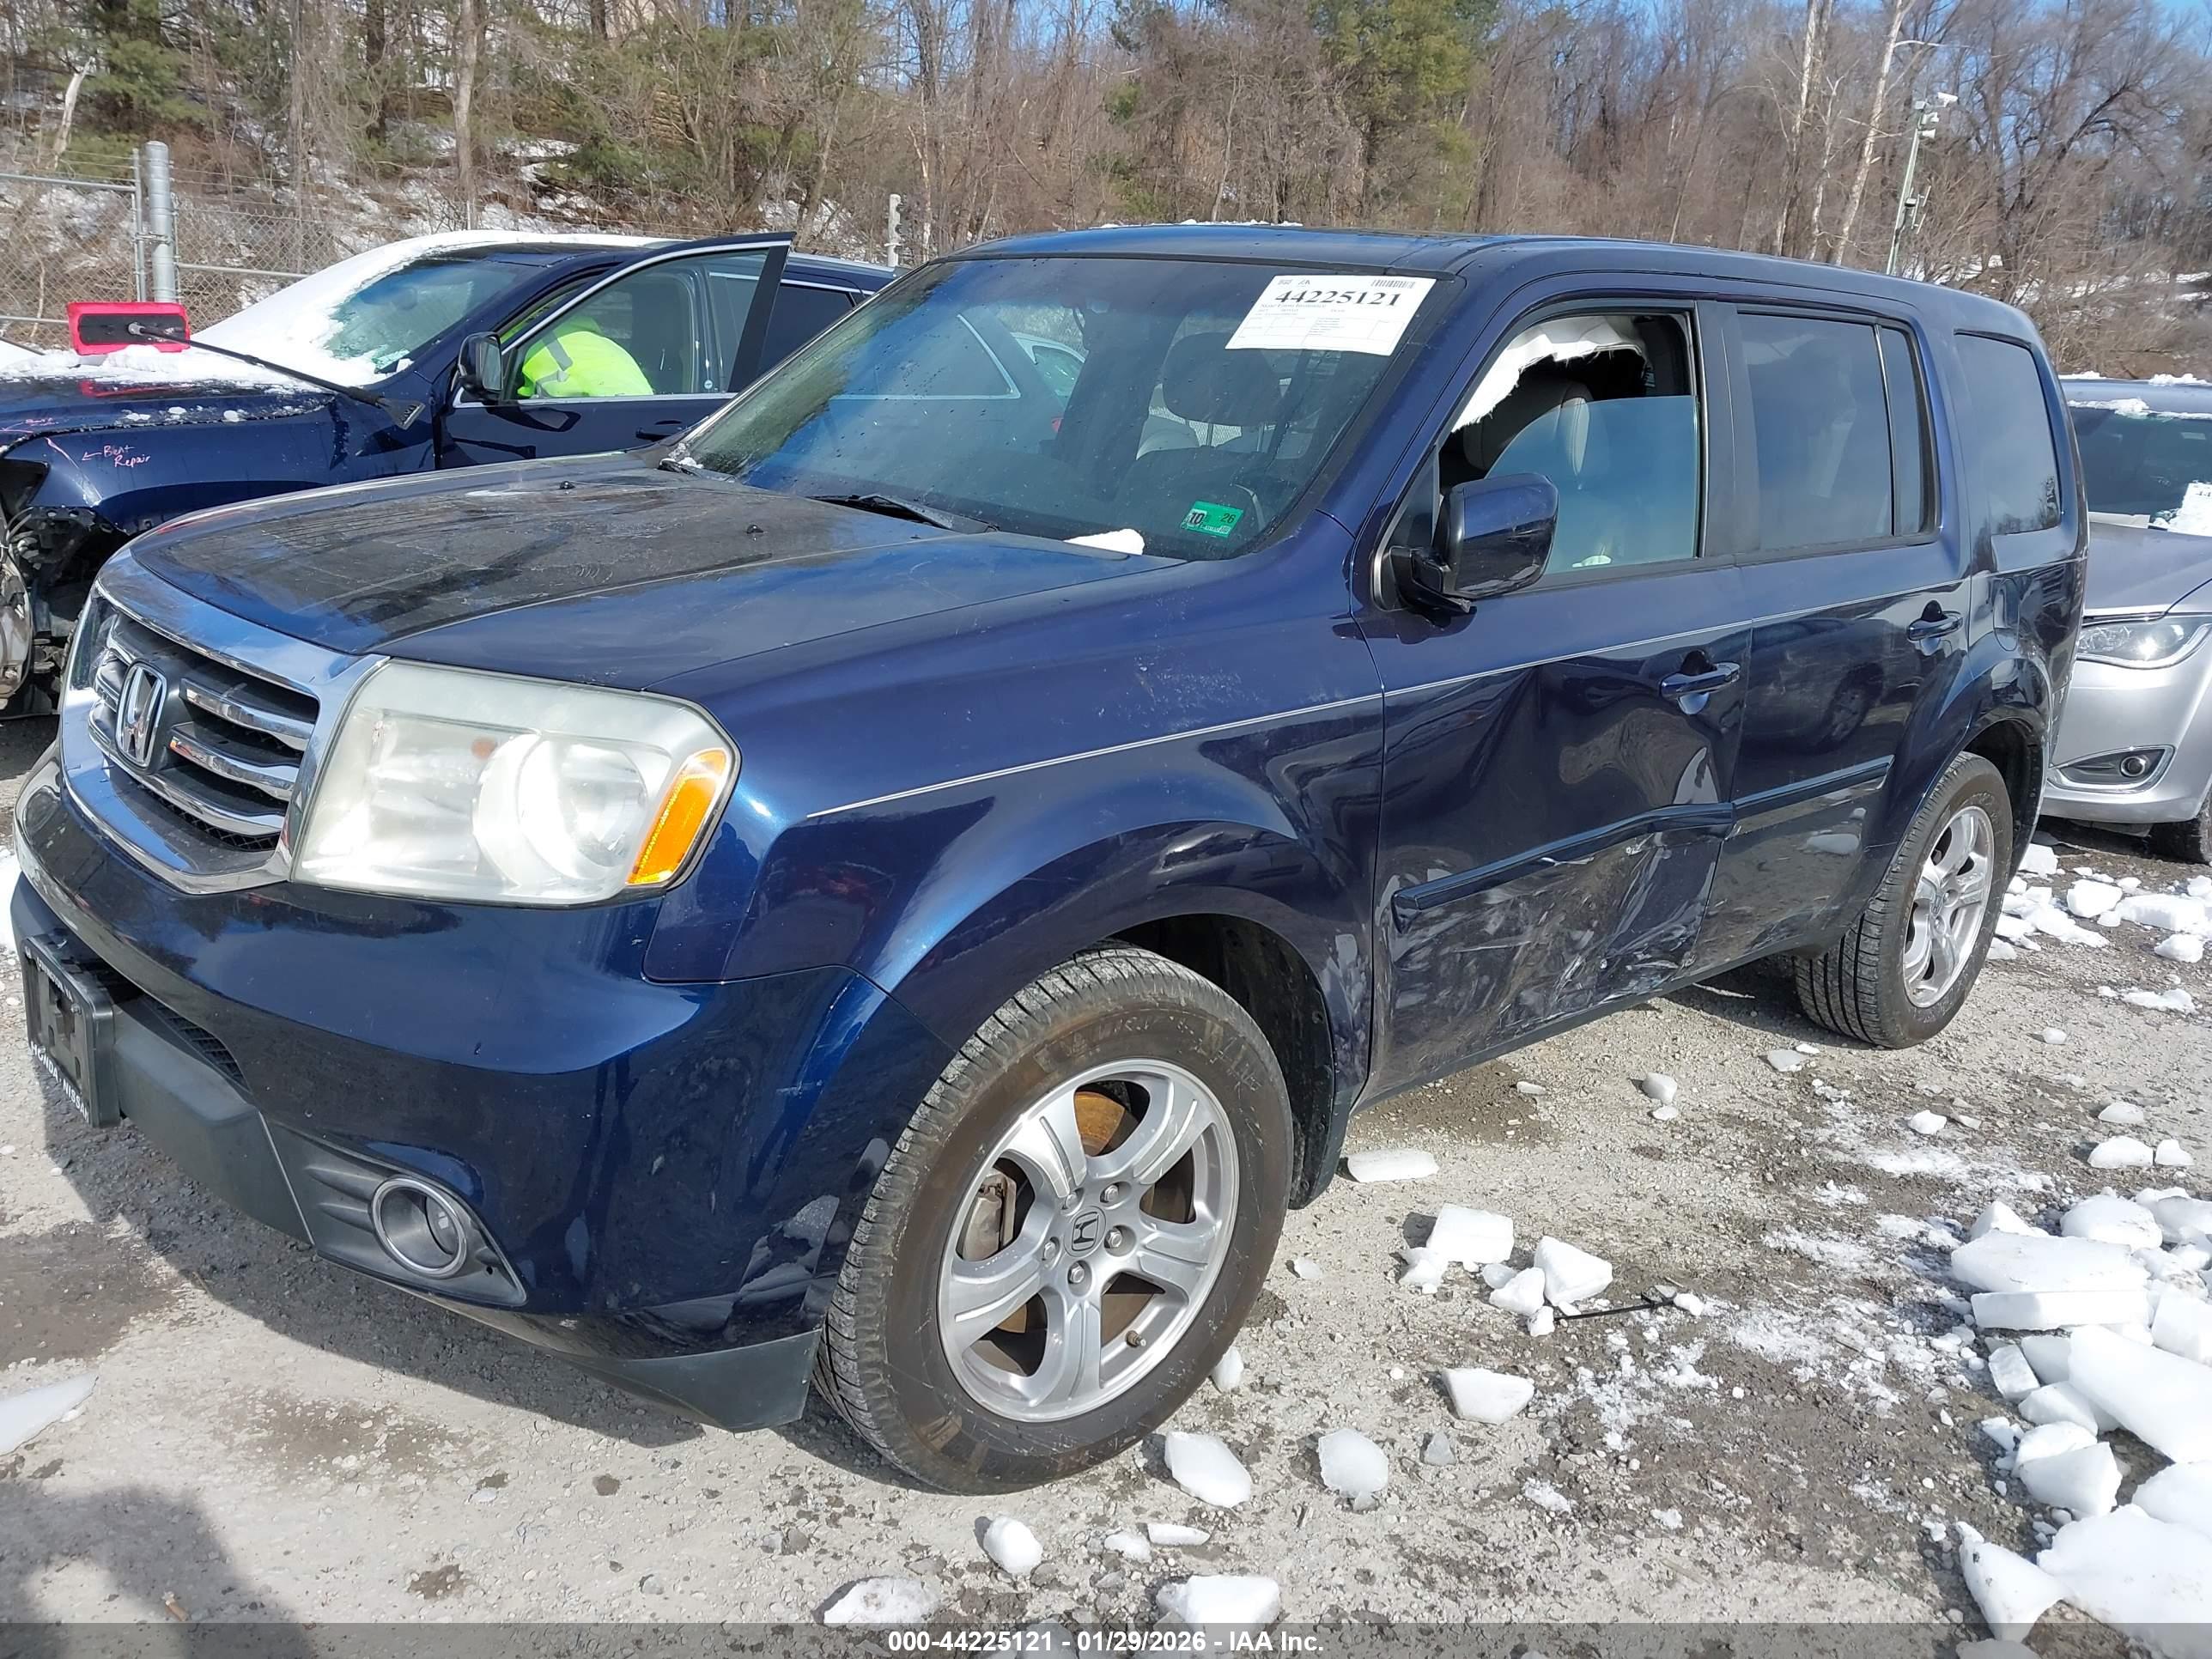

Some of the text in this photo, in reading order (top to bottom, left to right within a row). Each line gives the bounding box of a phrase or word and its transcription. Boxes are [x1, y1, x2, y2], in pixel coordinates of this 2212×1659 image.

[1274, 290, 1401, 306] 44225121
[114, 454, 150, 468] Repair
[1188, 512, 1237, 525] 10 26
[30, 1040, 89, 1123] HONDA NISSAN
